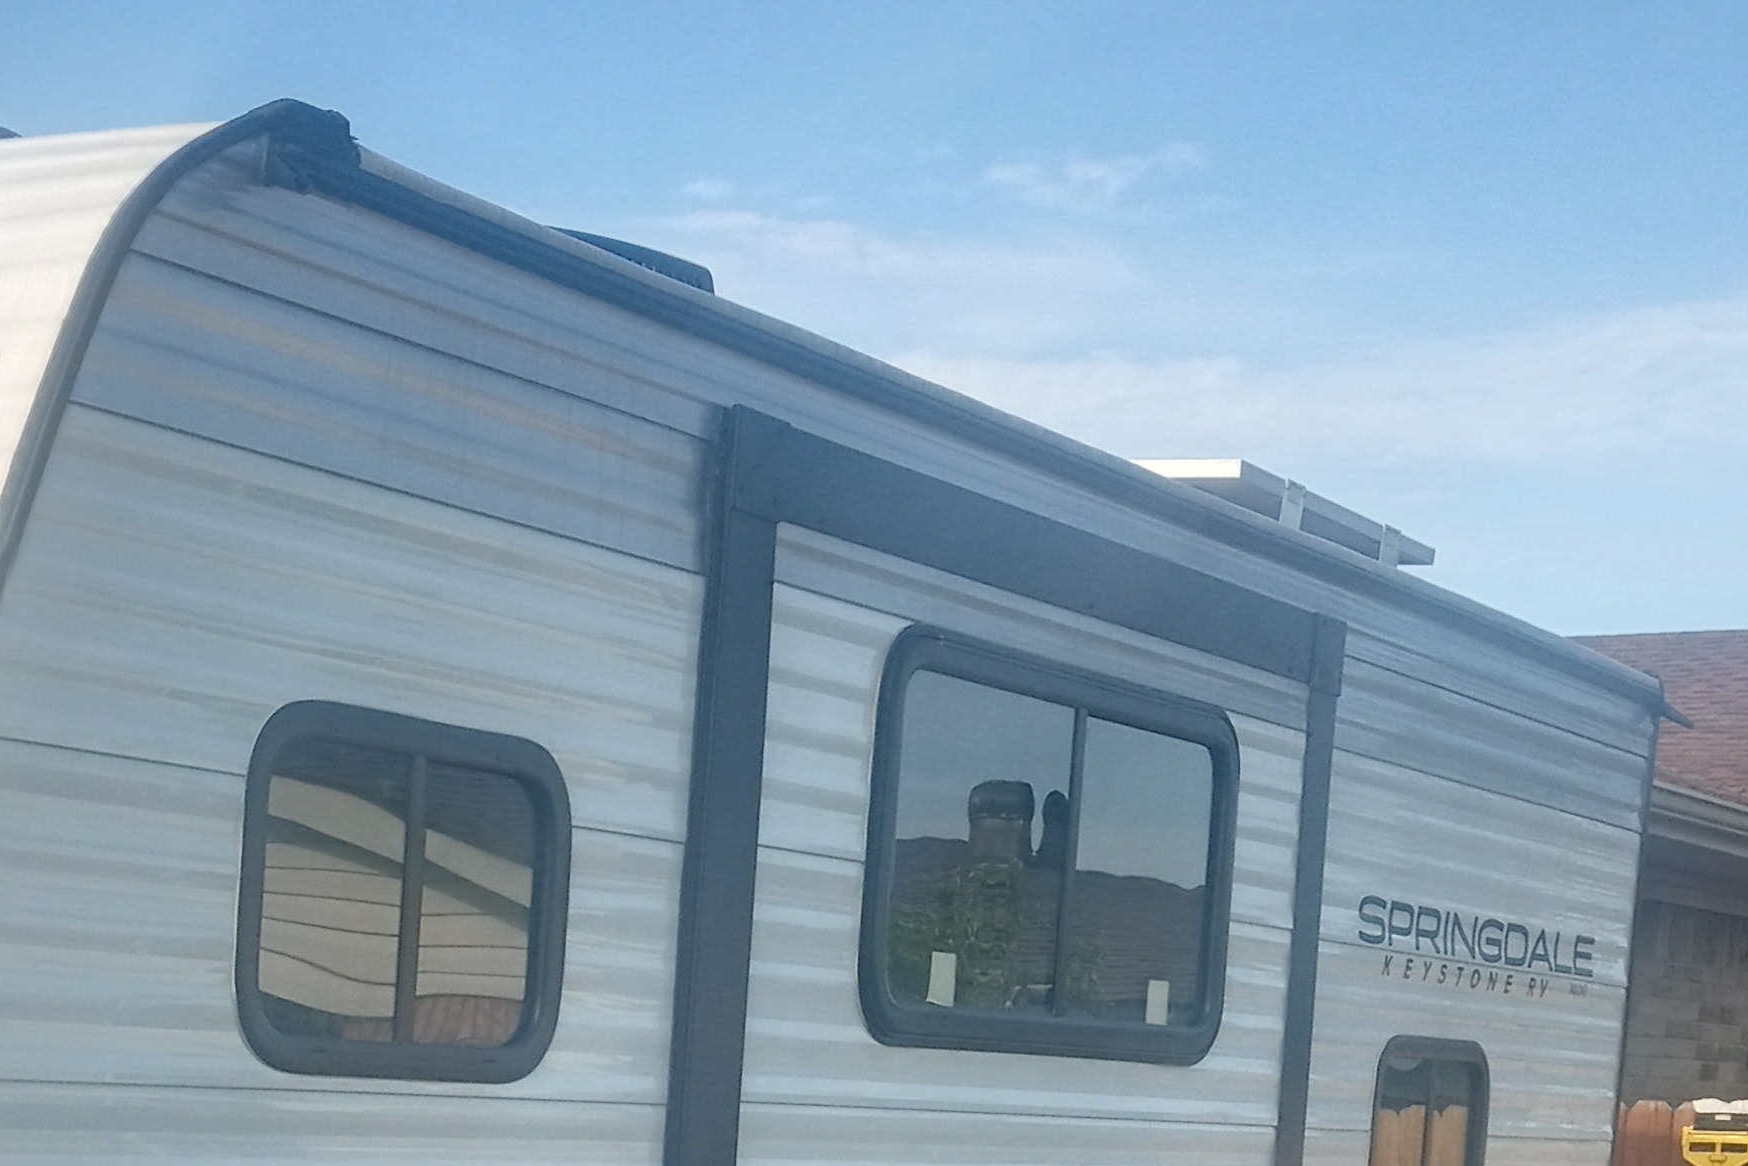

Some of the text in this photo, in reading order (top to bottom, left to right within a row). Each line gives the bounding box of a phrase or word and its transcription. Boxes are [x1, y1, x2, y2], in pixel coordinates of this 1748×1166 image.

[1358, 895, 1596, 978] SPRINGDALE
[1381, 954, 1514, 994] KEYSTONE
[1526, 977, 1549, 998] RV
